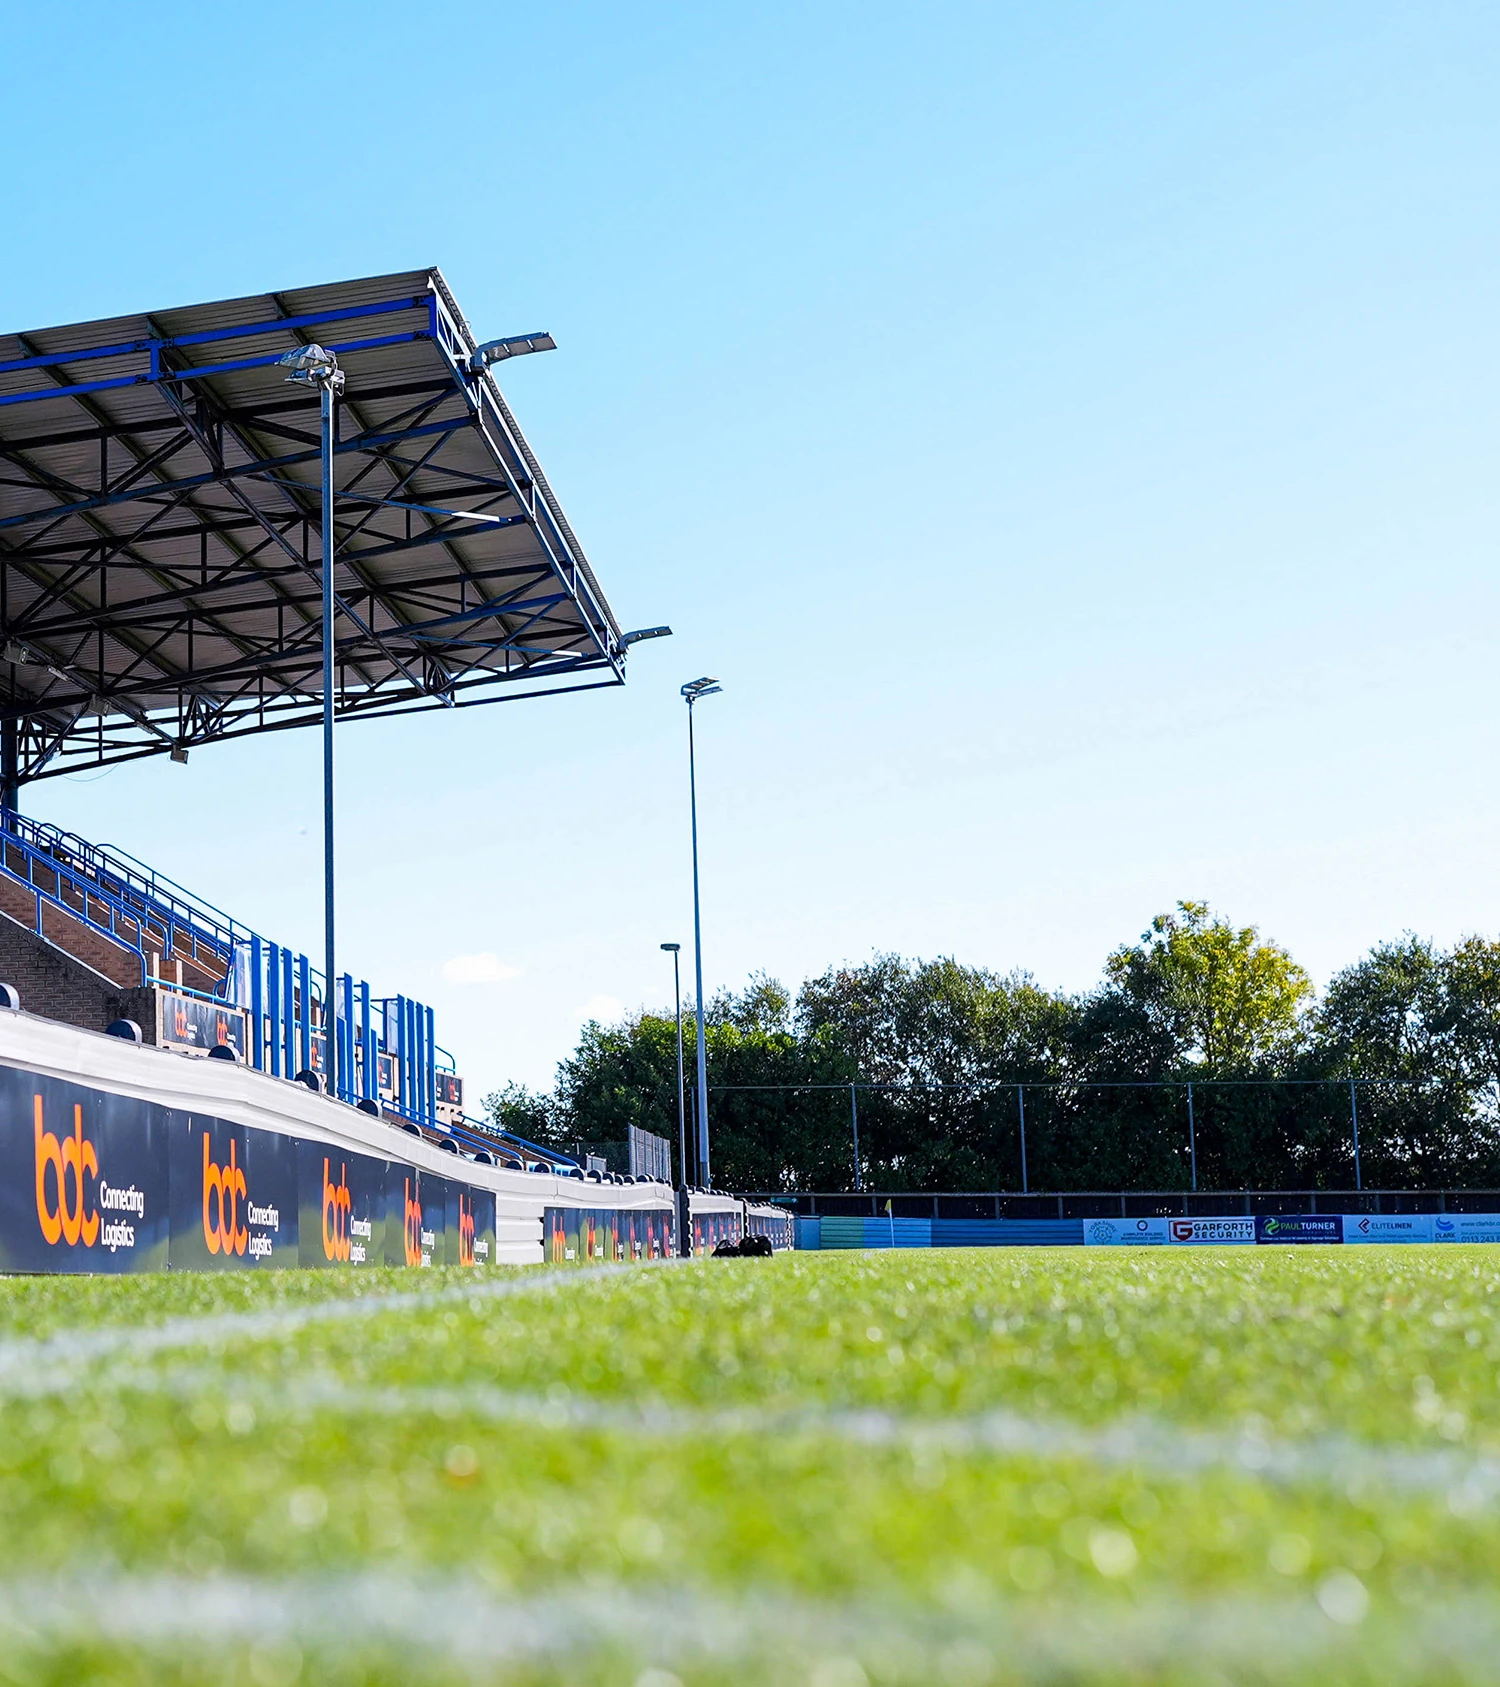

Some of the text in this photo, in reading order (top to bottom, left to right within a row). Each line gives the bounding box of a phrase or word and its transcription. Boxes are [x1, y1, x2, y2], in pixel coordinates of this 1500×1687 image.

[33, 1094, 100, 1248] bdc
[100, 1180, 145, 1219] Connecting
[202, 1131, 248, 1257] bdc
[247, 1200, 279, 1232] Connecting
[1193, 1222, 1253, 1231] GARFORTH
[101, 1217, 135, 1253] Logistics
[248, 1231, 273, 1260] Logistics
[1194, 1231, 1253, 1239] SECURITY
